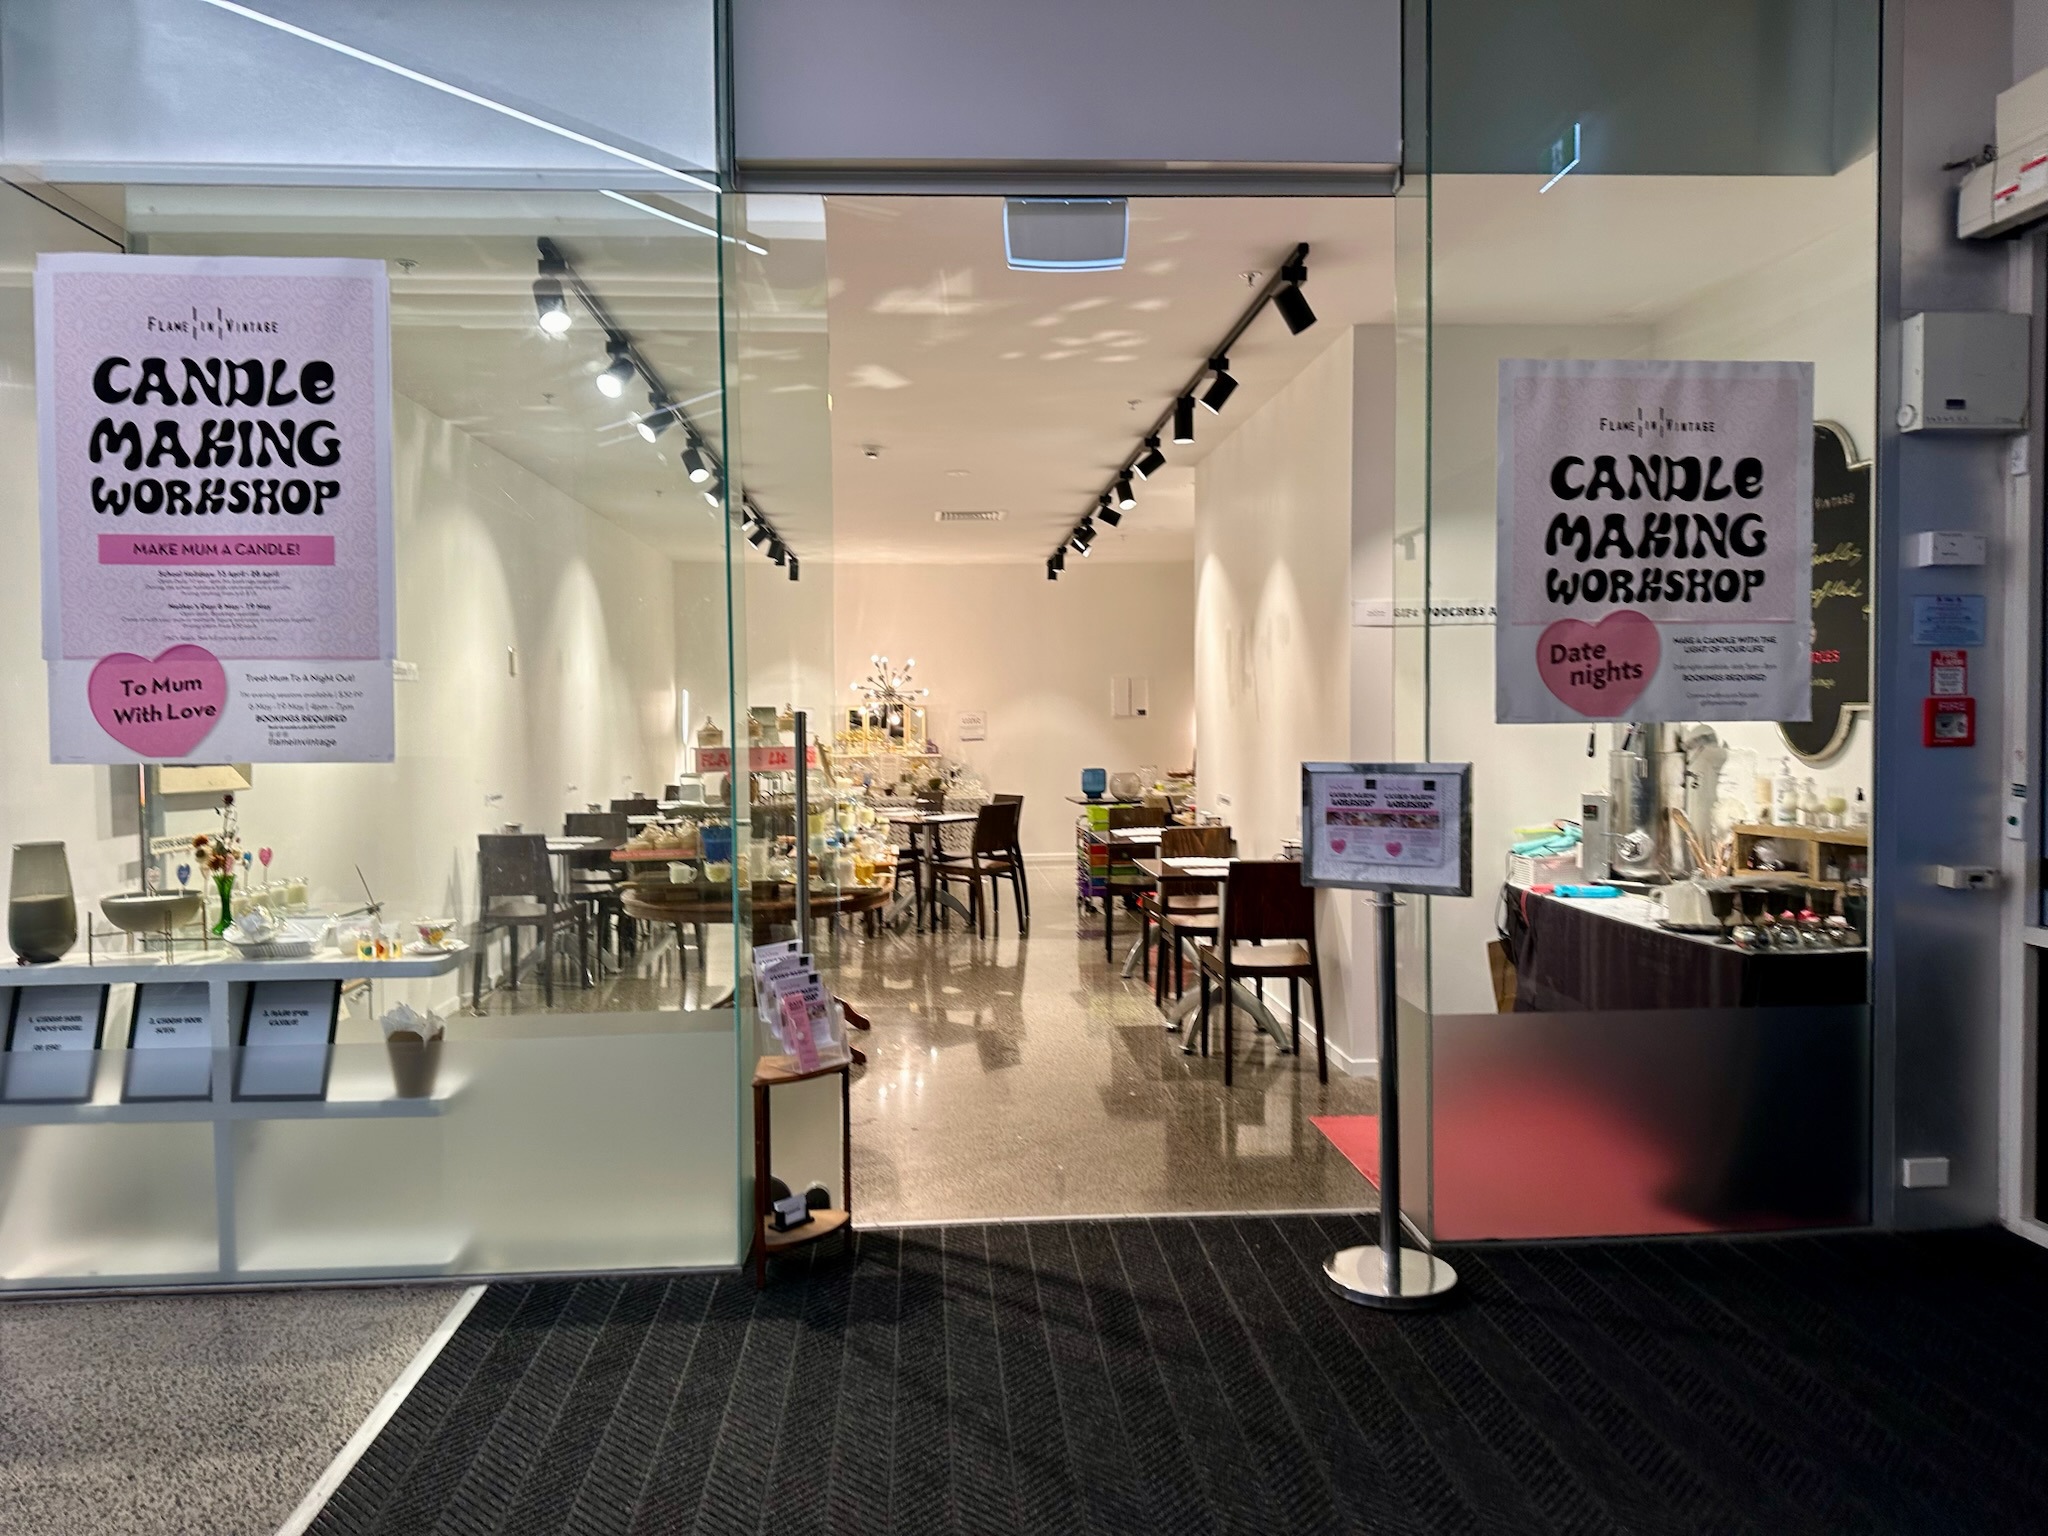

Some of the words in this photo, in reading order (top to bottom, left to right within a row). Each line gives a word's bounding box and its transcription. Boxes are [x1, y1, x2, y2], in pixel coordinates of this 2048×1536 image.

[147, 315, 189, 333] FLAME
[225, 320, 279, 335] VINTAGE
[89, 416, 343, 471] MAKING
[91, 476, 341, 517] WORKSHOP
[1545, 511, 1768, 563] MAKING
[132, 542, 178, 556] MAKE
[181, 542, 219, 556] MUM
[221, 543, 233, 556] A
[234, 542, 301, 557] CANDLE!
[1545, 567, 1766, 605] WORKSHOP
[1550, 641, 1606, 665] Date
[245, 673, 268, 682] Treat
[290, 673, 302, 682] To
[310, 673, 334, 684] Night
[1569, 660, 1644, 690] nights
[119, 679, 147, 698] To
[151, 677, 203, 694] Mum
[113, 703, 164, 725] With
[166, 702, 218, 721] Love
[255, 714, 301, 723] BOOKINGS
